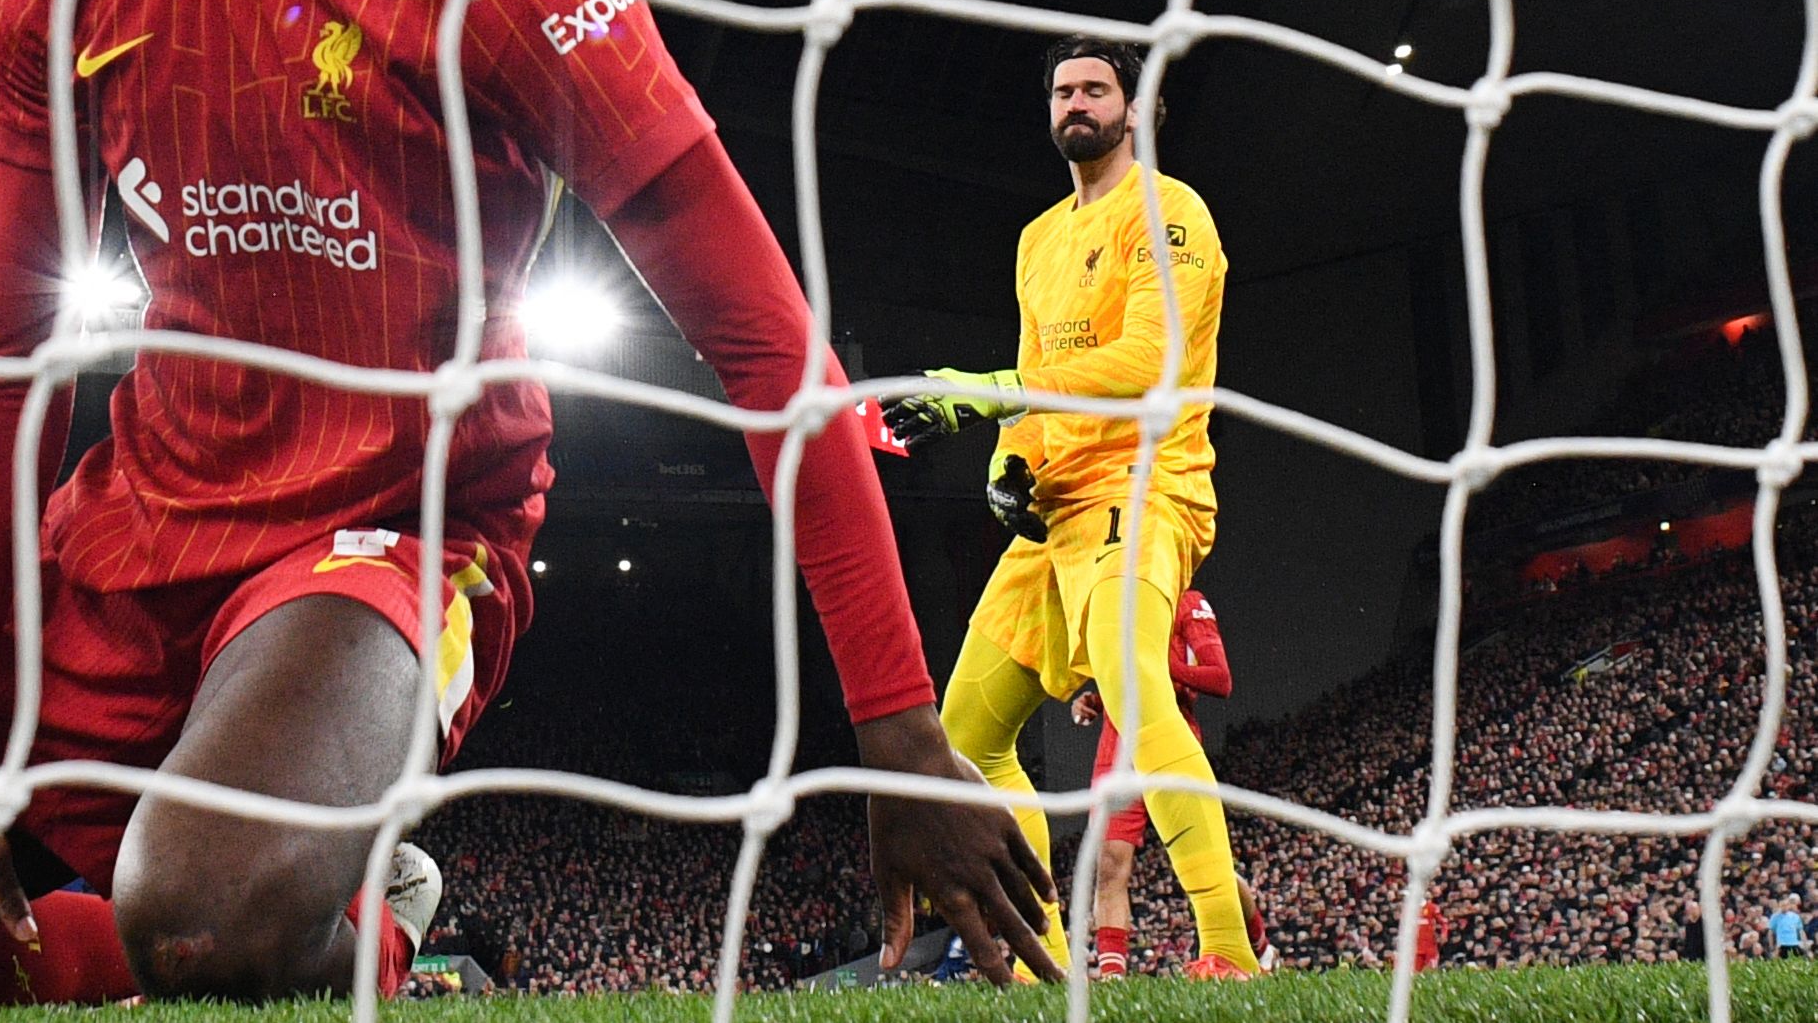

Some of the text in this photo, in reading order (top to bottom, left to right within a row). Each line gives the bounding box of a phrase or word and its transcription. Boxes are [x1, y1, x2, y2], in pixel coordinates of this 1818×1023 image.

[182, 178, 361, 230] standard
[185, 219, 378, 271] chartered
[1136, 247, 1205, 270] Exedia
[1104, 505, 1122, 546] 1
